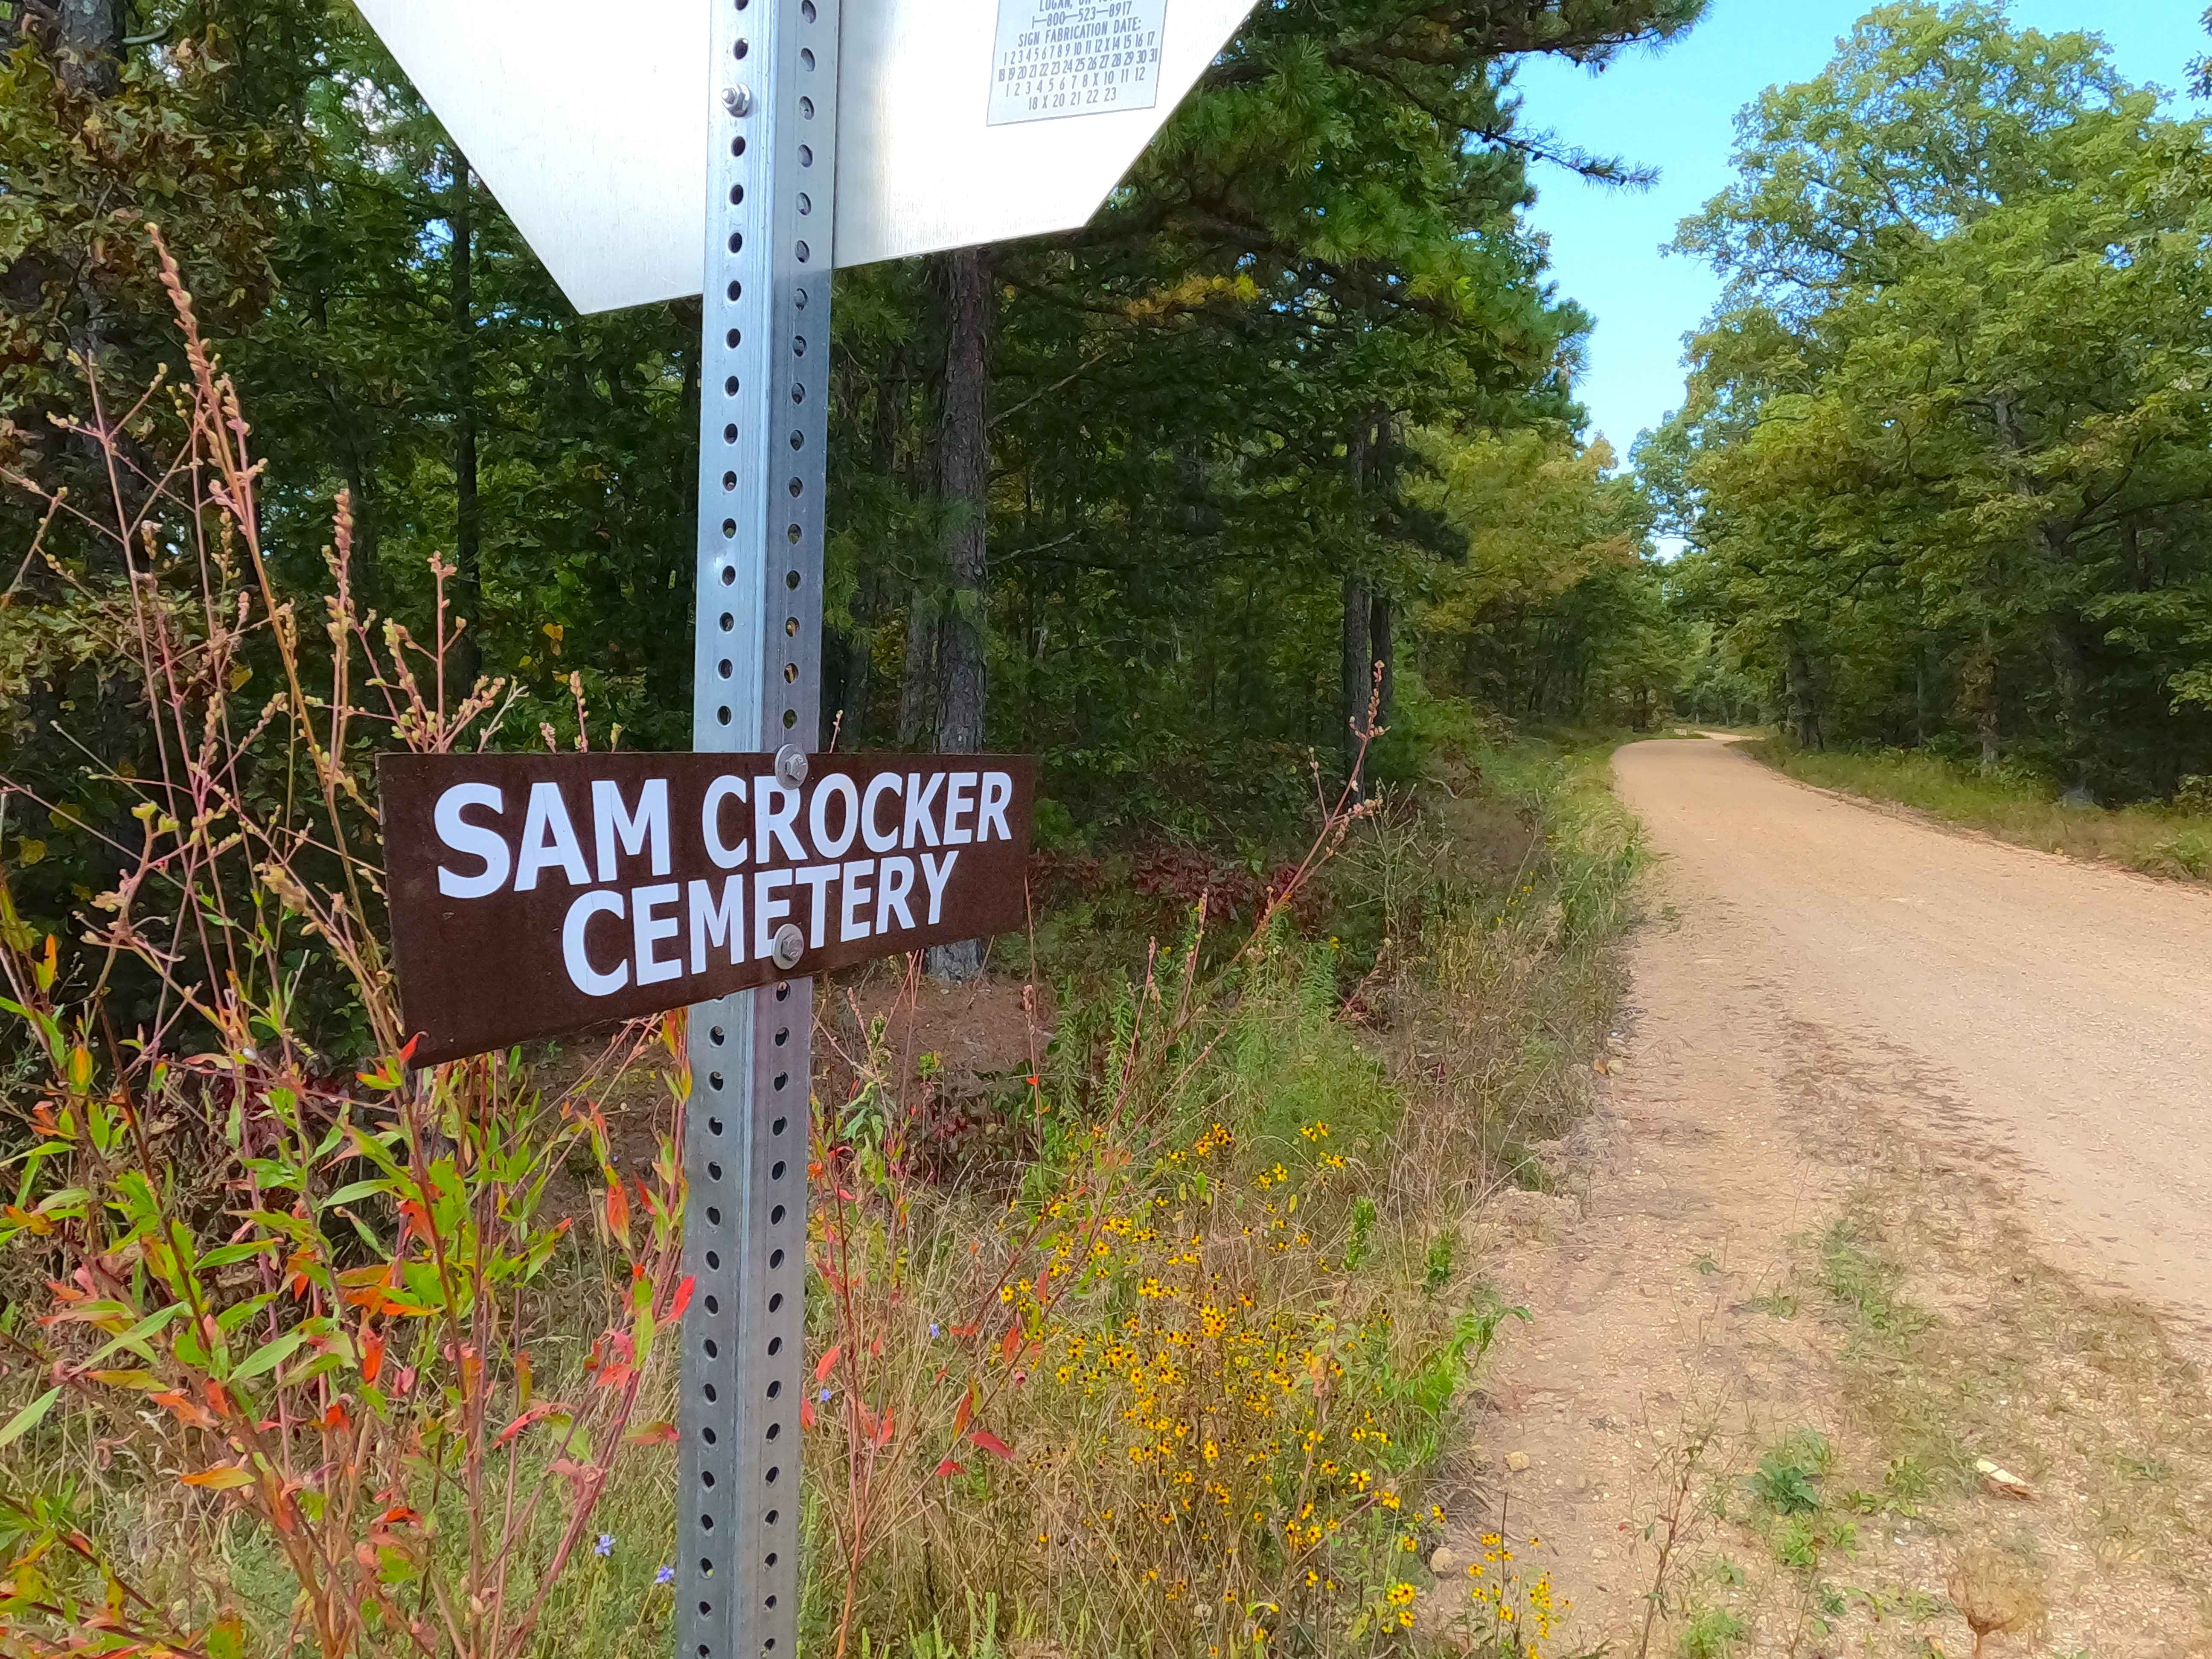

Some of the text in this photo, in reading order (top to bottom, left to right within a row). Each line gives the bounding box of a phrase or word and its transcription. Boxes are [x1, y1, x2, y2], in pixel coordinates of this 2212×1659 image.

[1004, 31, 1155, 66] 1 2 3 4 5 6 7 8 9 10 11 12 X 14 15 16 17
[1018, 17, 1141, 47] SIGN FABRICATION DATE:
[998, 48, 1158, 82] 18 19 20 21 22 23 24 25 26 27 28 29 30 31
[1006, 67, 1146, 98] 1 2 3 4 5 6 7 8 X 10 11 12
[1028, 87, 1117, 111] 18 X 20 21 22 23
[434, 772, 1011, 898] SAM CROCKER
[563, 851, 959, 996] CEMETERY
